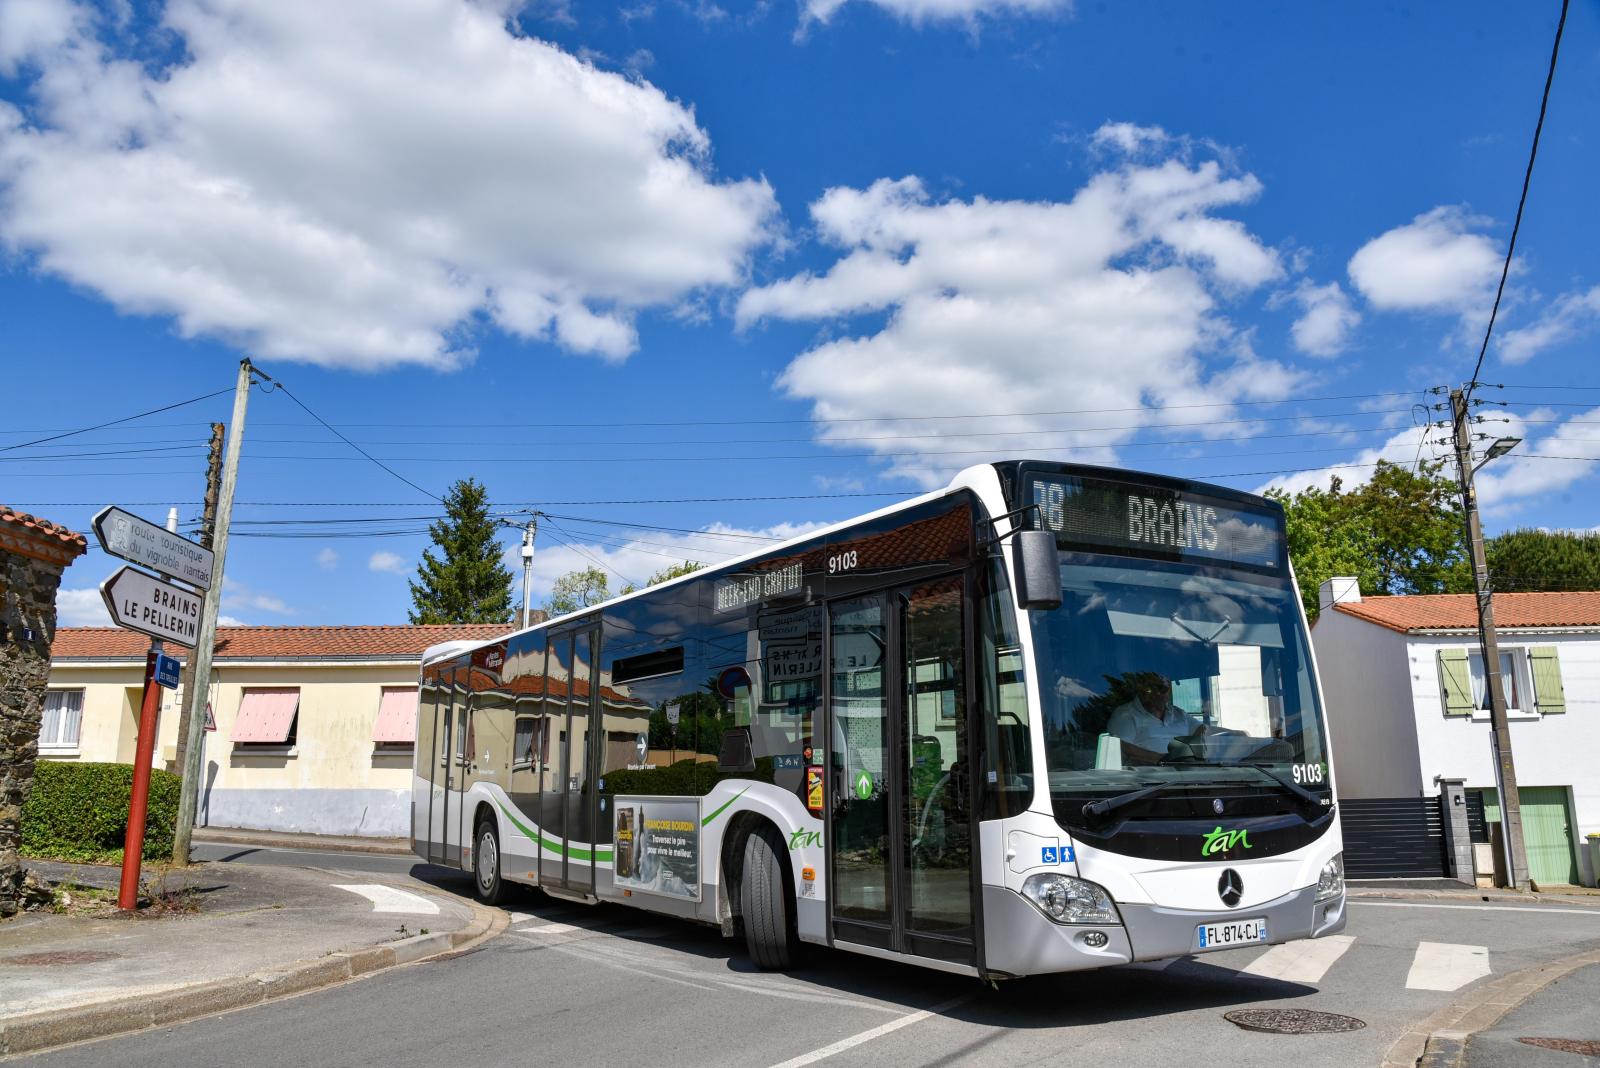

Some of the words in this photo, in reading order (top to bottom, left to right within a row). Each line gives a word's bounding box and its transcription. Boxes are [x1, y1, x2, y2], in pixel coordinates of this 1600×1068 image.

[1128, 495, 1218, 551] BRAINS
[130, 539, 141, 554] du
[147, 547, 180, 570] vignoble
[183, 565, 209, 582] nantais
[161, 537, 203, 563] touristique
[829, 550, 857, 574] 9103
[153, 588, 197, 617] BRAINS
[718, 577, 761, 610] WEEK-END
[124, 600, 138, 618] LE
[143, 606, 195, 638] PELLERIN
[1292, 763, 1322, 784] 9103
[789, 826, 824, 850] tan
[1201, 826, 1253, 856] tan
